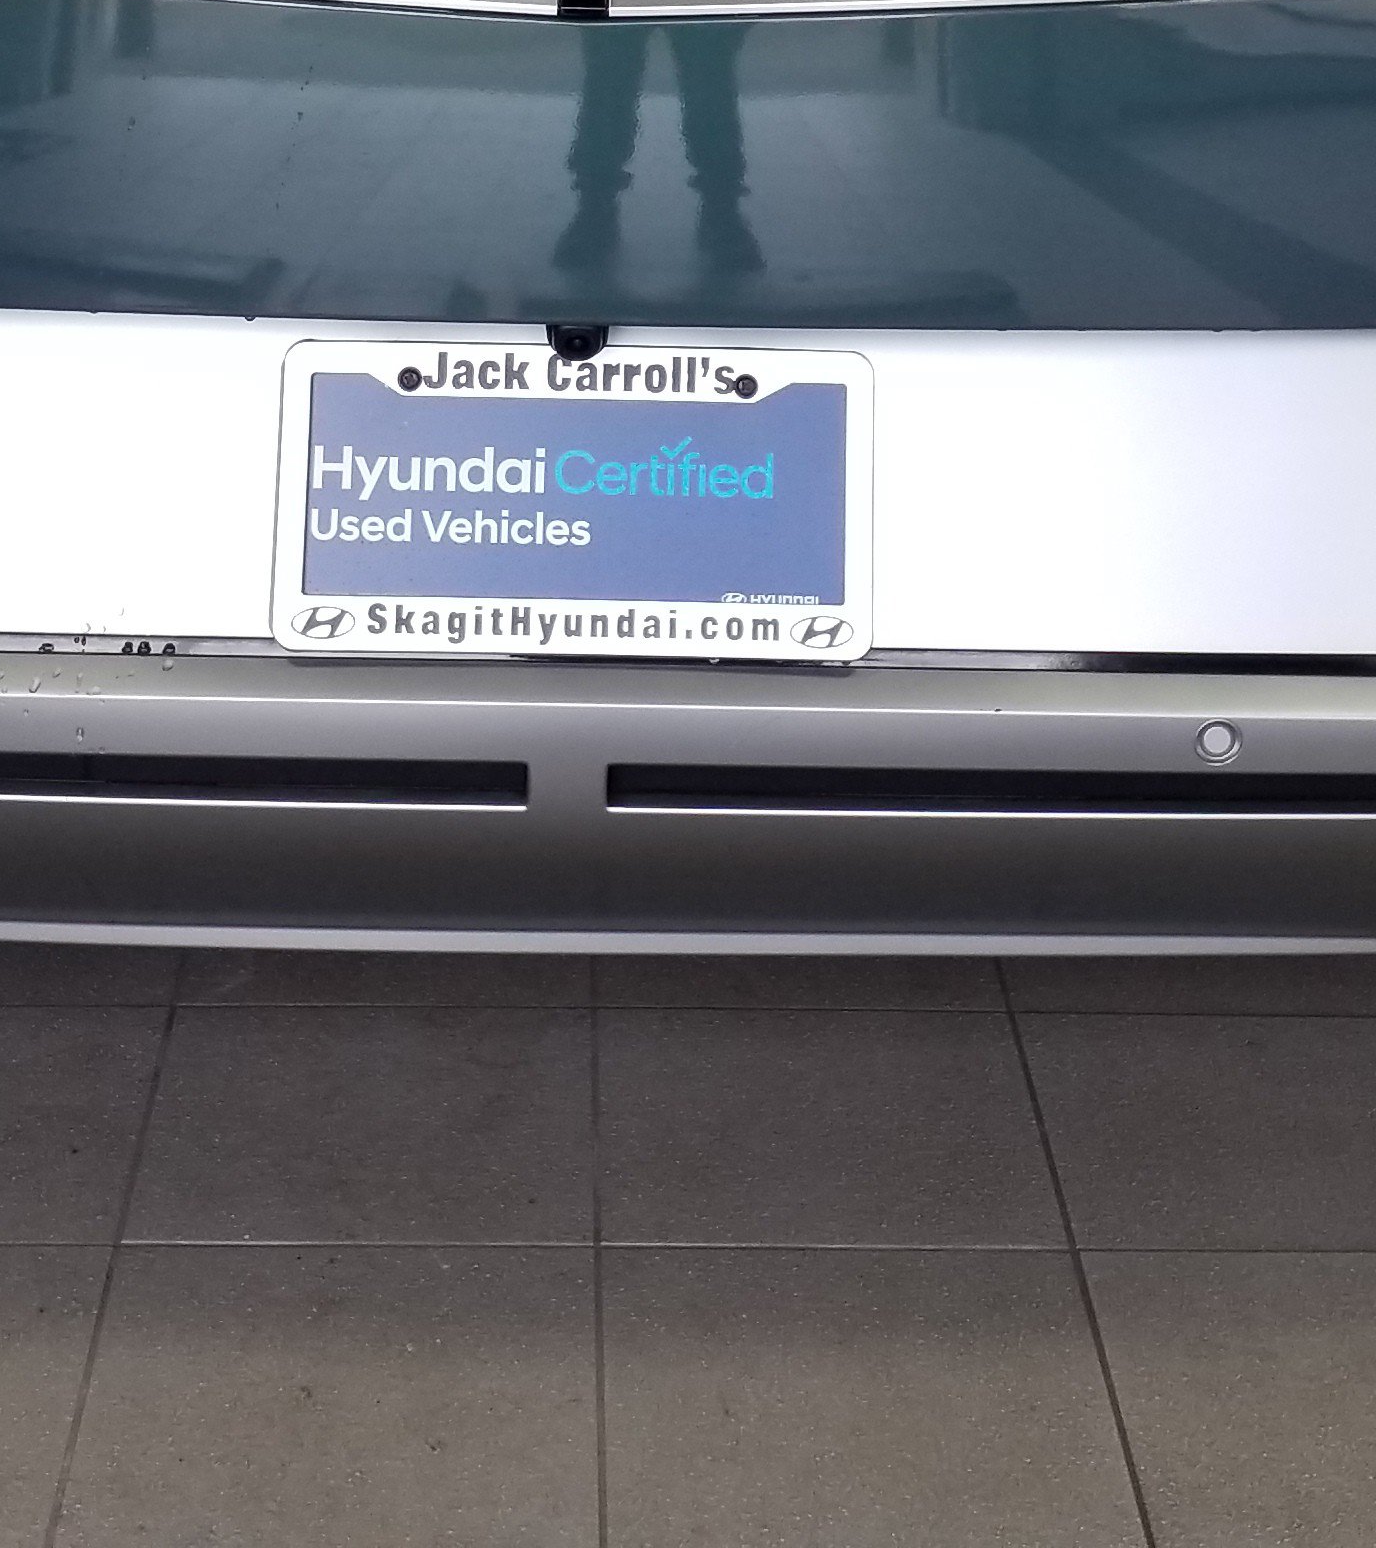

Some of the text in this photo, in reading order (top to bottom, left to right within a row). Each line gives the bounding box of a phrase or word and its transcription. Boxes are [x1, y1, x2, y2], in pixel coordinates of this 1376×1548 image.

[423, 352, 736, 395] Jack Carroll's
[311, 436, 775, 501] Hyundai Certified
[310, 508, 591, 546] Used Vehicles
[366, 603, 781, 646] SkagitHyundai.com
